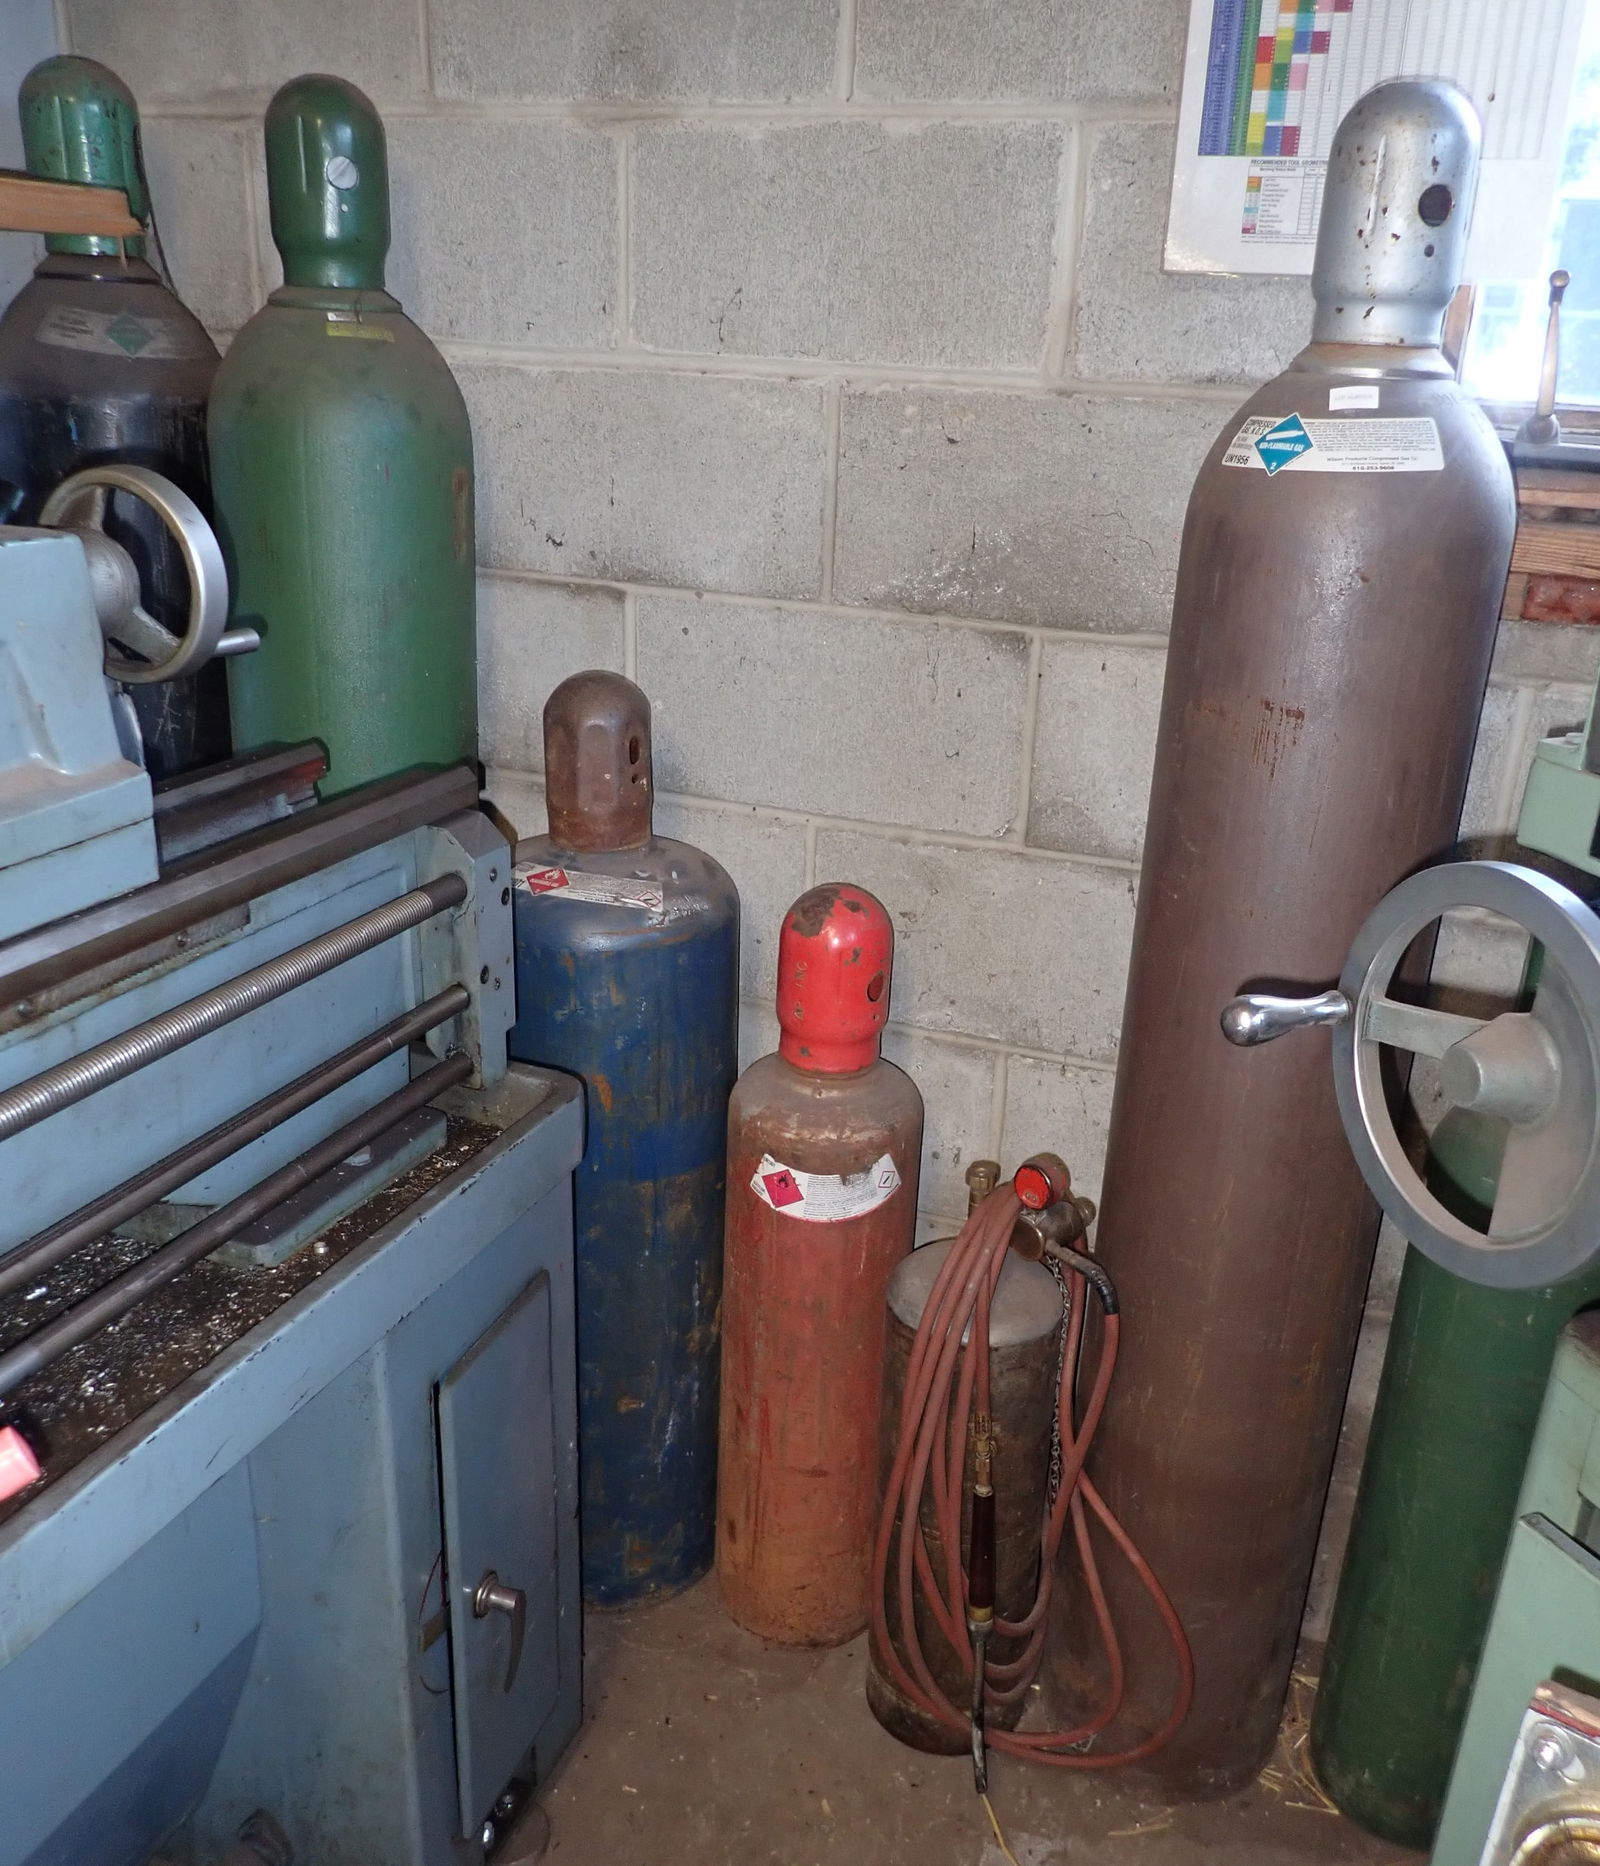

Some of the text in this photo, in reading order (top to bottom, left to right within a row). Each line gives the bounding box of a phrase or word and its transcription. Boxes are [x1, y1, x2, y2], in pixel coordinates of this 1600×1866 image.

[1259, 441, 1294, 452] NON-FLAMMABLE
[1294, 443, 1305, 453] GAS
[1225, 454, 1250, 466] UN1956
[1270, 462, 1277, 470] 2
